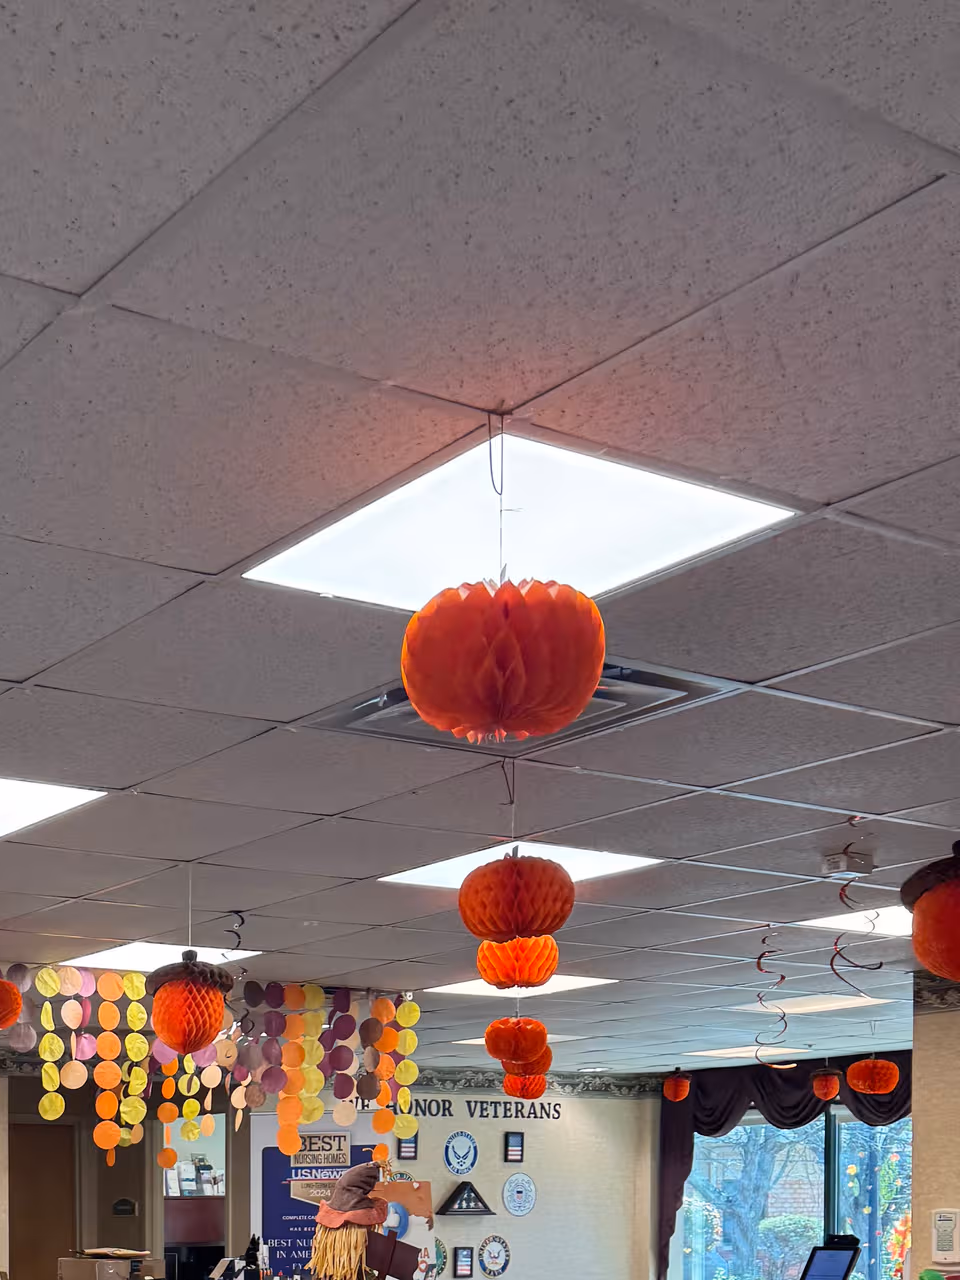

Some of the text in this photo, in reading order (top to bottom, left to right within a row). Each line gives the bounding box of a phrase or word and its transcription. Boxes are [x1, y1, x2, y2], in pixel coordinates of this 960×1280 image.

[465, 1099, 562, 1120] VETERANS
[299, 1135, 347, 1152] BEST
[294, 1152, 347, 1165] NURSING HOMES
[309, 1189, 331, 1197] 2024
[268, 1239, 293, 1248] BEST
[276, 1250, 287, 1259] IN
